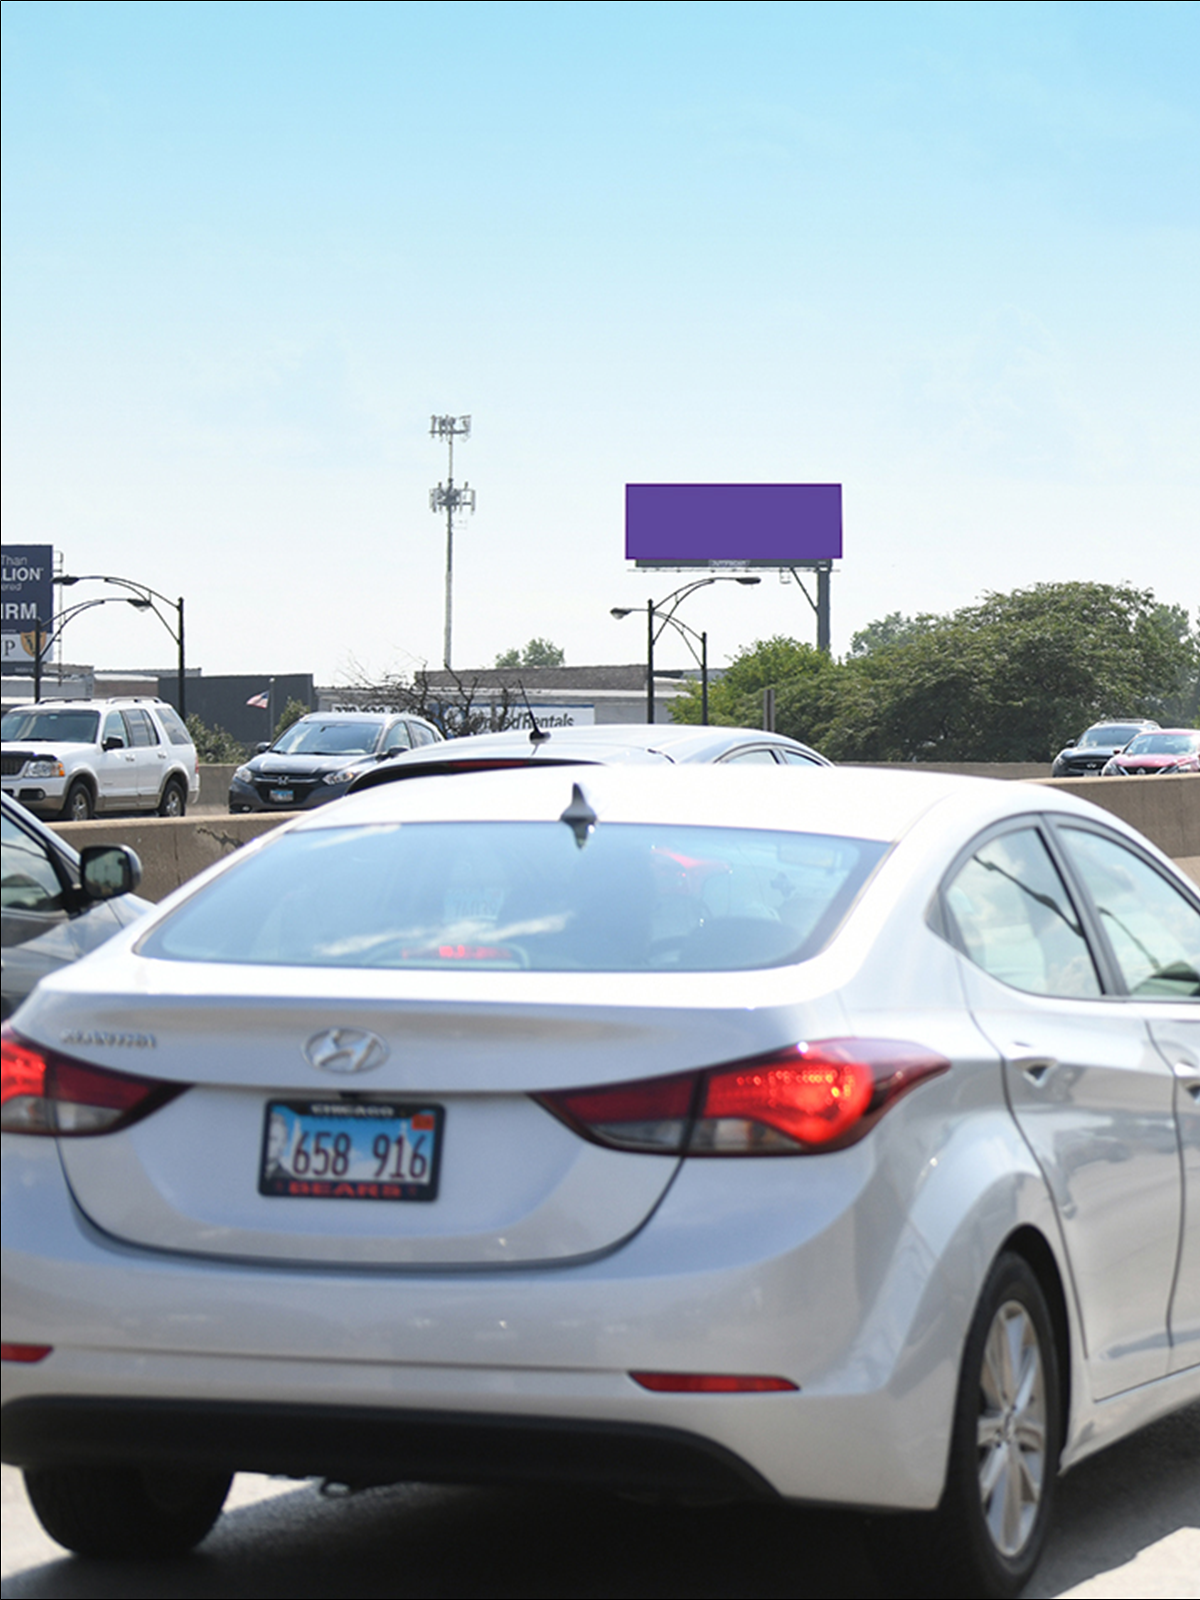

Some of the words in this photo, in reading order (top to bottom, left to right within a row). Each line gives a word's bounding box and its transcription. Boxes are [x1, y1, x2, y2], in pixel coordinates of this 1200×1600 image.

[2, 567, 40, 582] LION
[292, 1131, 350, 1176] 658
[372, 1133, 428, 1179] 916
[288, 1181, 402, 1198] BEARS
